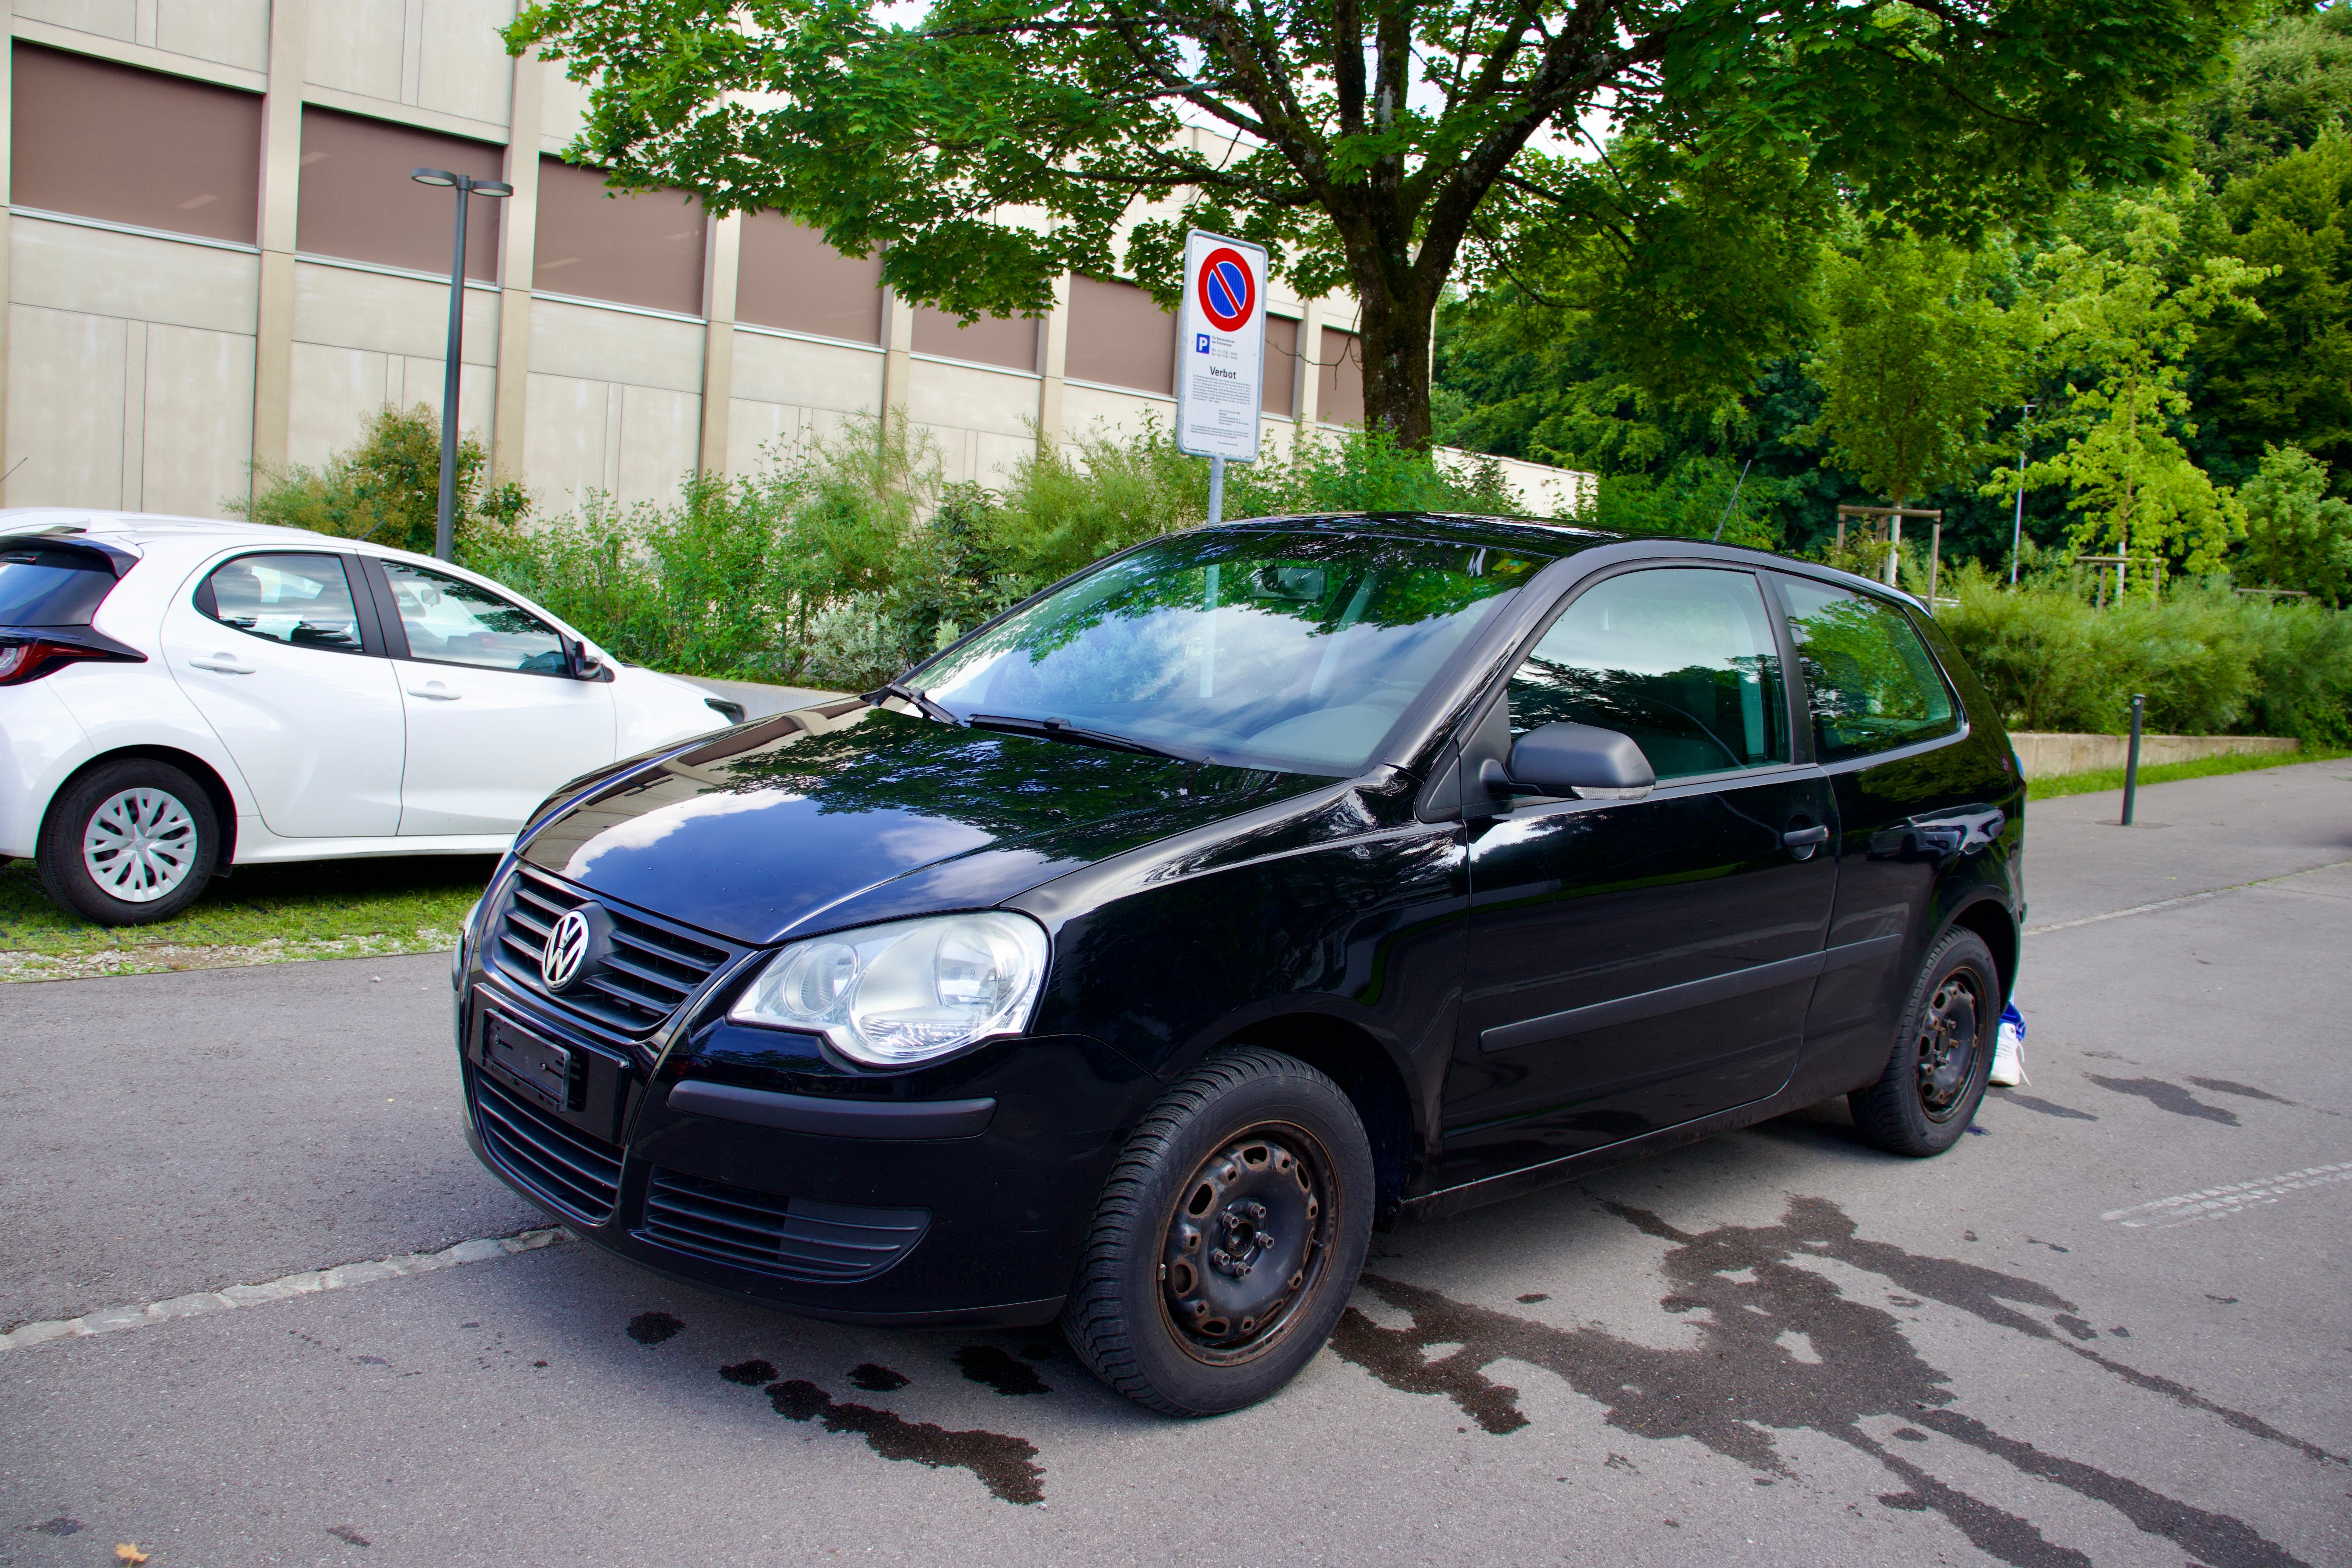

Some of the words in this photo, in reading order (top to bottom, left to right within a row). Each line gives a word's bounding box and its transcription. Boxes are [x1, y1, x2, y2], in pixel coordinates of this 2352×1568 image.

[1199, 337, 1208, 351] P
[1210, 366, 1236, 379] Verbot
[542, 911, 589, 989] VW
